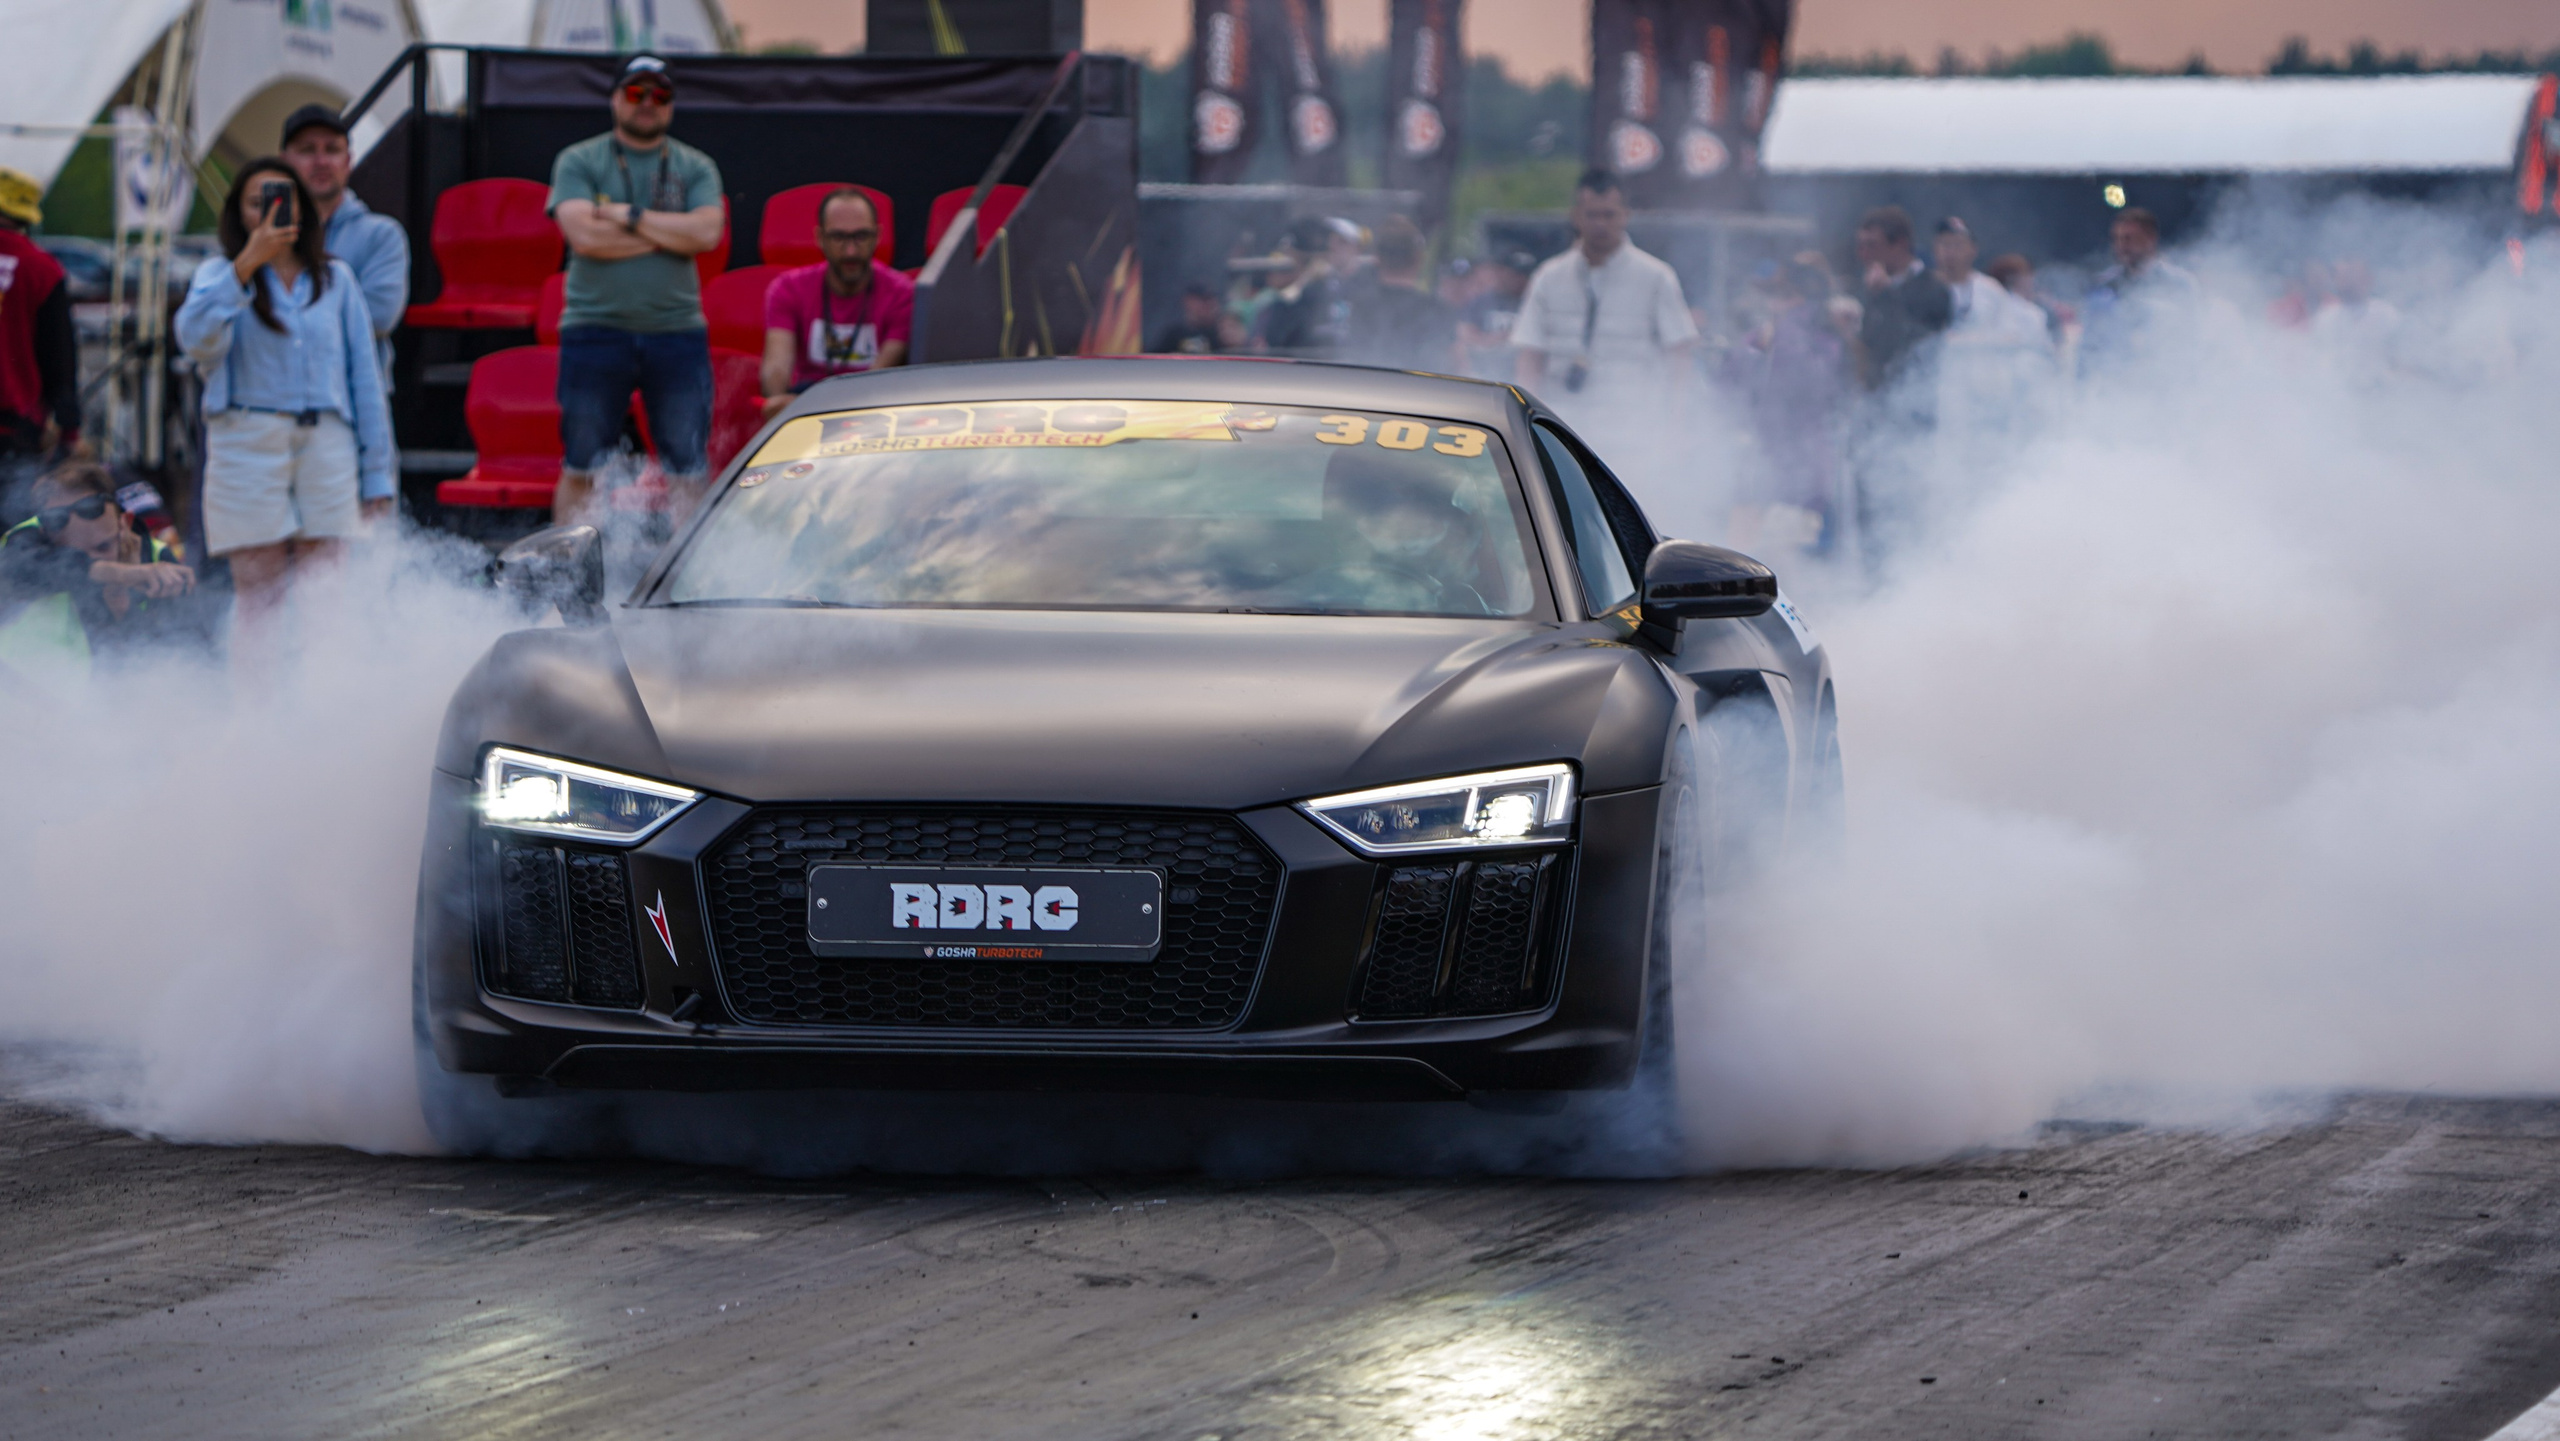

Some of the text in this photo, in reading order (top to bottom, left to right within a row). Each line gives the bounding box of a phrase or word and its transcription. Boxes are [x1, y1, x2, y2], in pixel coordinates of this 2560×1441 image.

[818, 405, 1128, 443] RDRC
[1314, 414, 1488, 458] 303
[890, 882, 1079, 930] RDRC
[937, 946, 1043, 959] GOSHATURBOTECH
